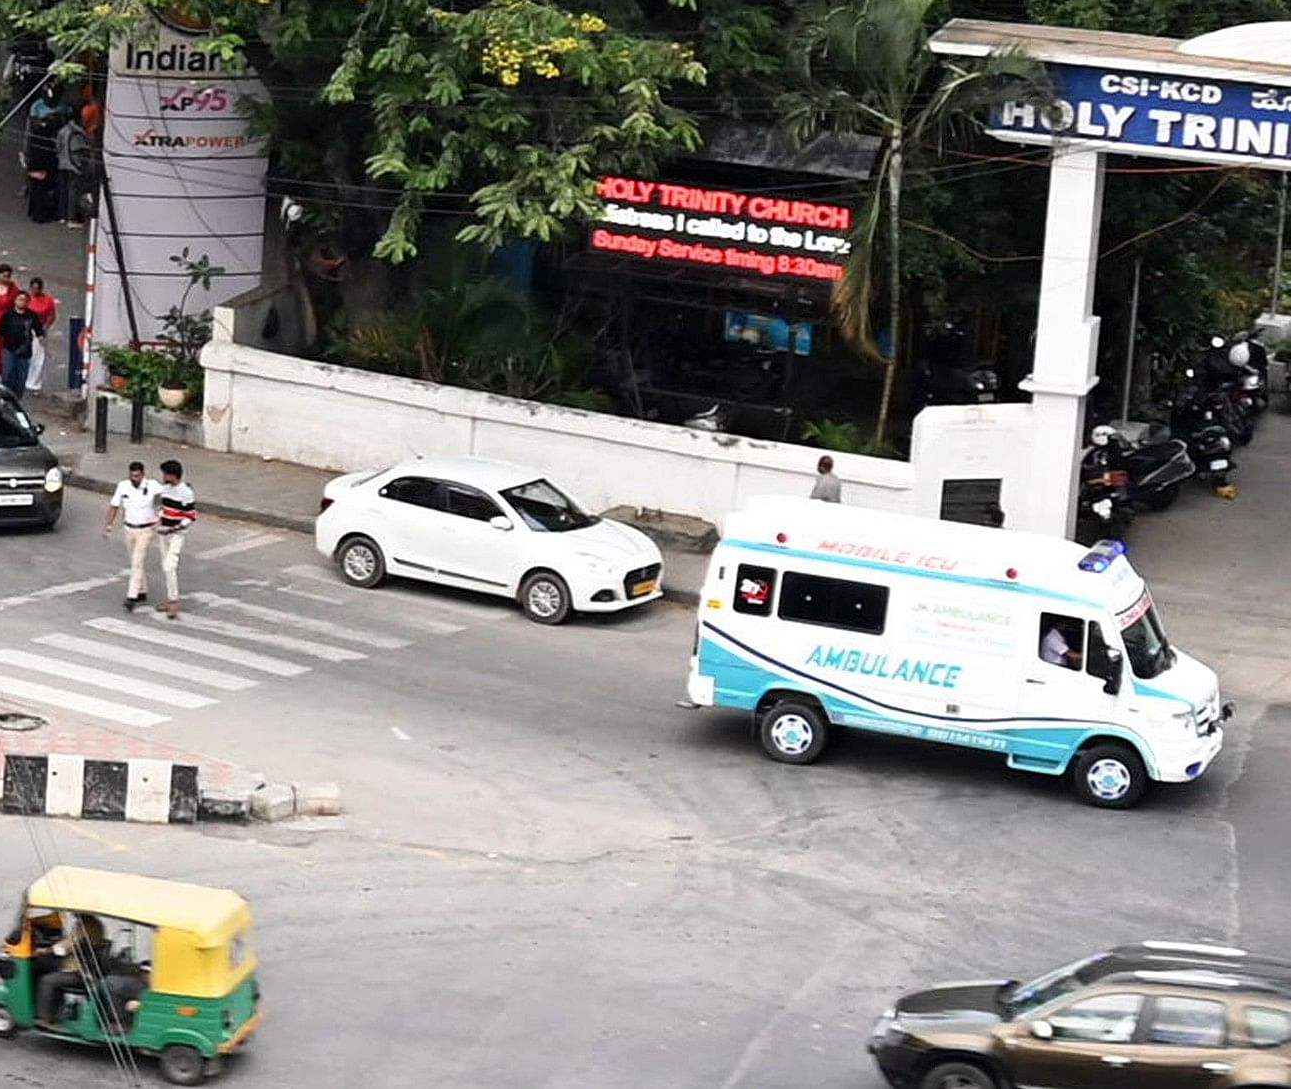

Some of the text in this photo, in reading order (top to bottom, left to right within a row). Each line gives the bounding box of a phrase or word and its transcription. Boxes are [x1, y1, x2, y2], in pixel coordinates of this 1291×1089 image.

[160, 86, 227, 111] XP95
[1099, 73, 1223, 104] CSI-KCD
[1000, 99, 1136, 138] HOLY
[660, 184, 748, 216] TRINITY
[748, 196, 850, 229] CHURCH
[686, 217, 746, 241] called
[746, 224, 769, 244] to
[769, 226, 803, 248] the
[593, 229, 845, 280] Sunday Service timing 8:30am
[817, 540, 959, 571] MOBILE ICU
[932, 603, 1011, 626] AMBULANCE
[804, 644, 963, 688] AMBULANCE
